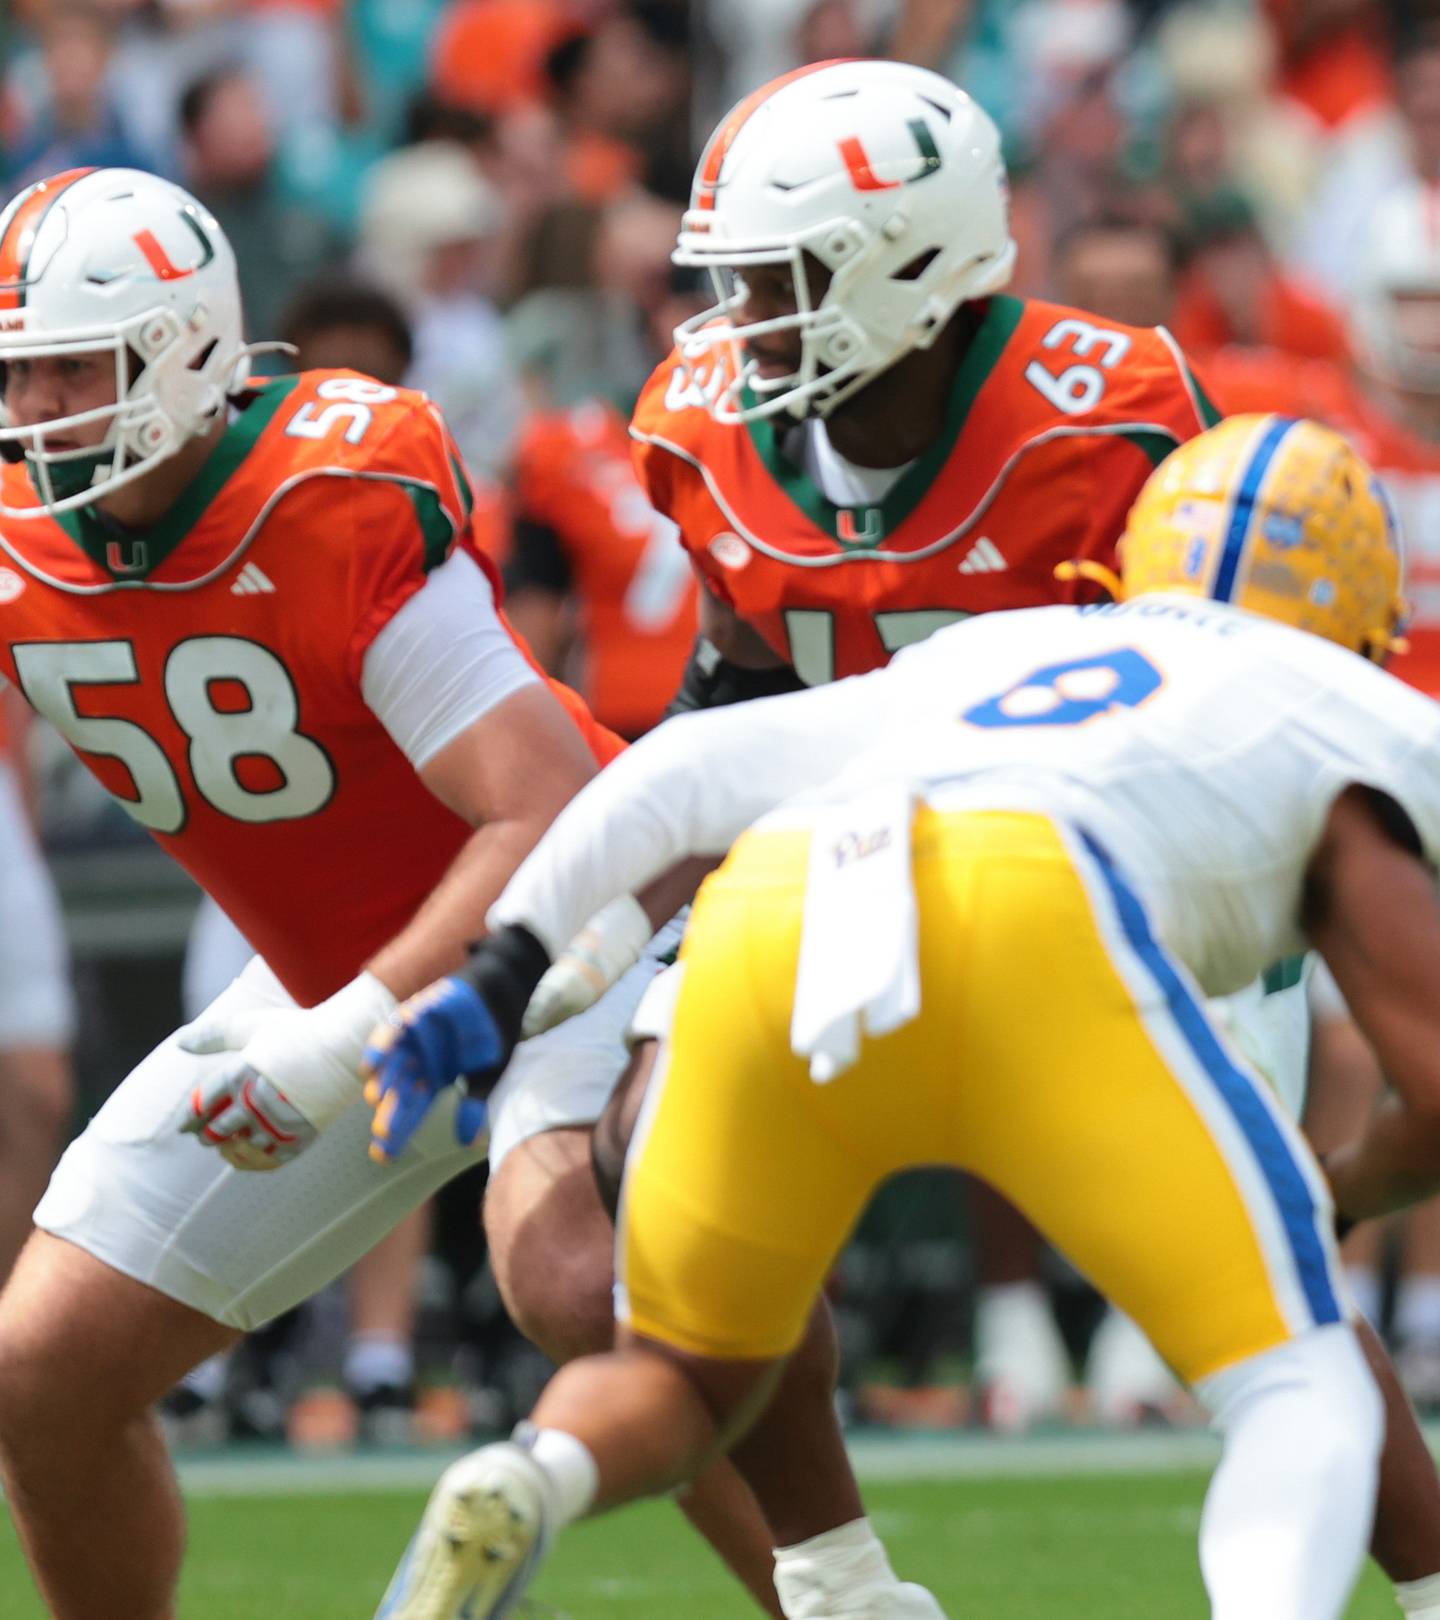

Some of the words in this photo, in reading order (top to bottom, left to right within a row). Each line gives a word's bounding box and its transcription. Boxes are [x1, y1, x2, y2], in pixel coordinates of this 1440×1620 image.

[837, 117, 942, 192] U
[133, 208, 214, 281] U
[1025, 318, 1132, 415] 63
[284, 378, 398, 445] 58
[106, 541, 147, 572] U
[837, 509, 882, 543] U
[960, 646, 1166, 729] 8
[10, 633, 338, 835] 58
